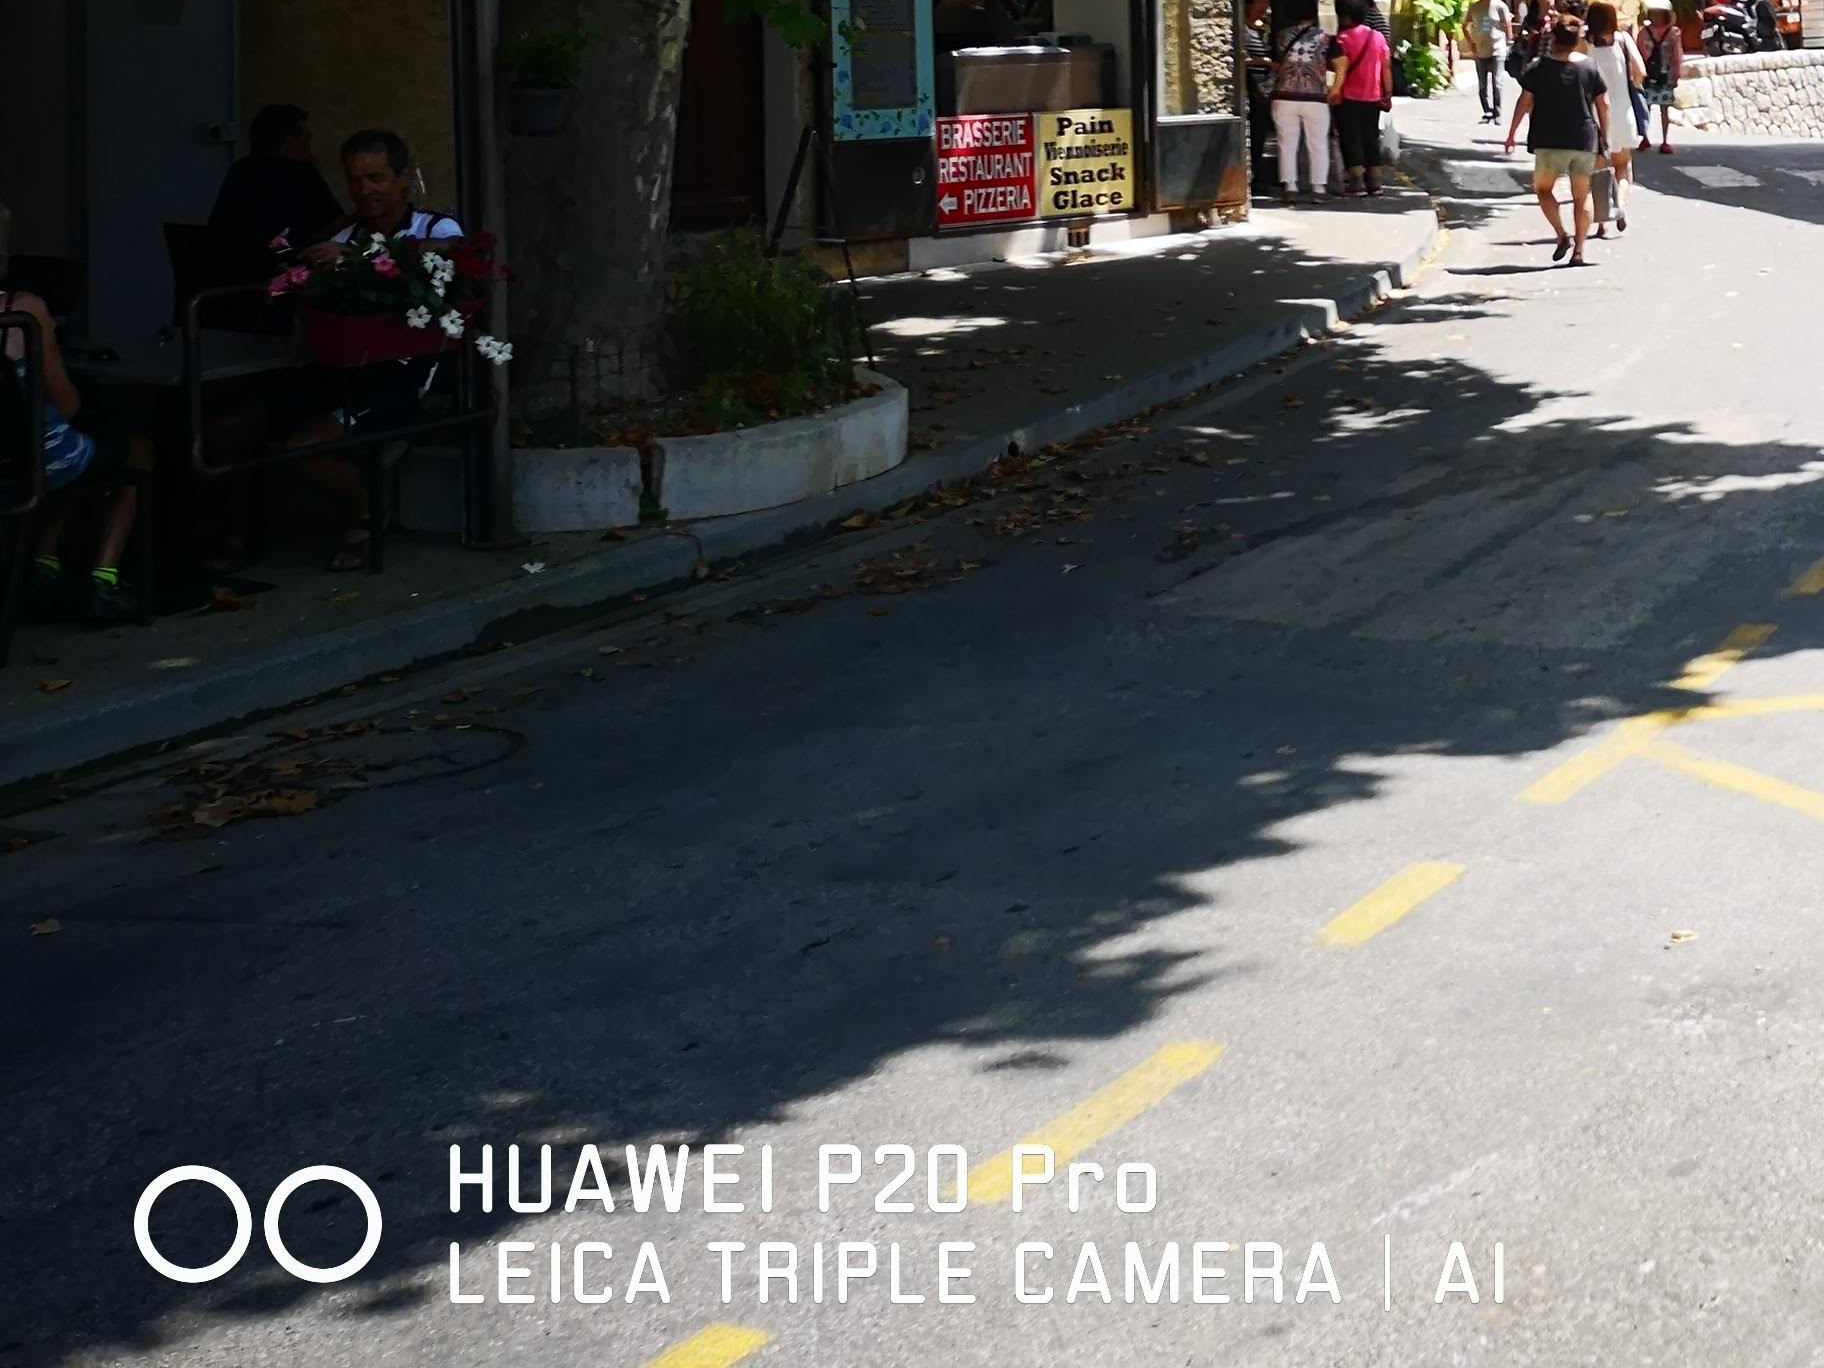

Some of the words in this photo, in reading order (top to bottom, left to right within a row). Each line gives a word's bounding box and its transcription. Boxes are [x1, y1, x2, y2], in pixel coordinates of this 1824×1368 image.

[941, 120, 1027, 150] BRASSERIE
[1056, 116, 1114, 136] Pain
[939, 152, 1033, 184] RESTAURANT
[1050, 163, 1126, 186] Snack
[963, 185, 1032, 215] PIZZERIA
[1053, 190, 1123, 210] Glace
